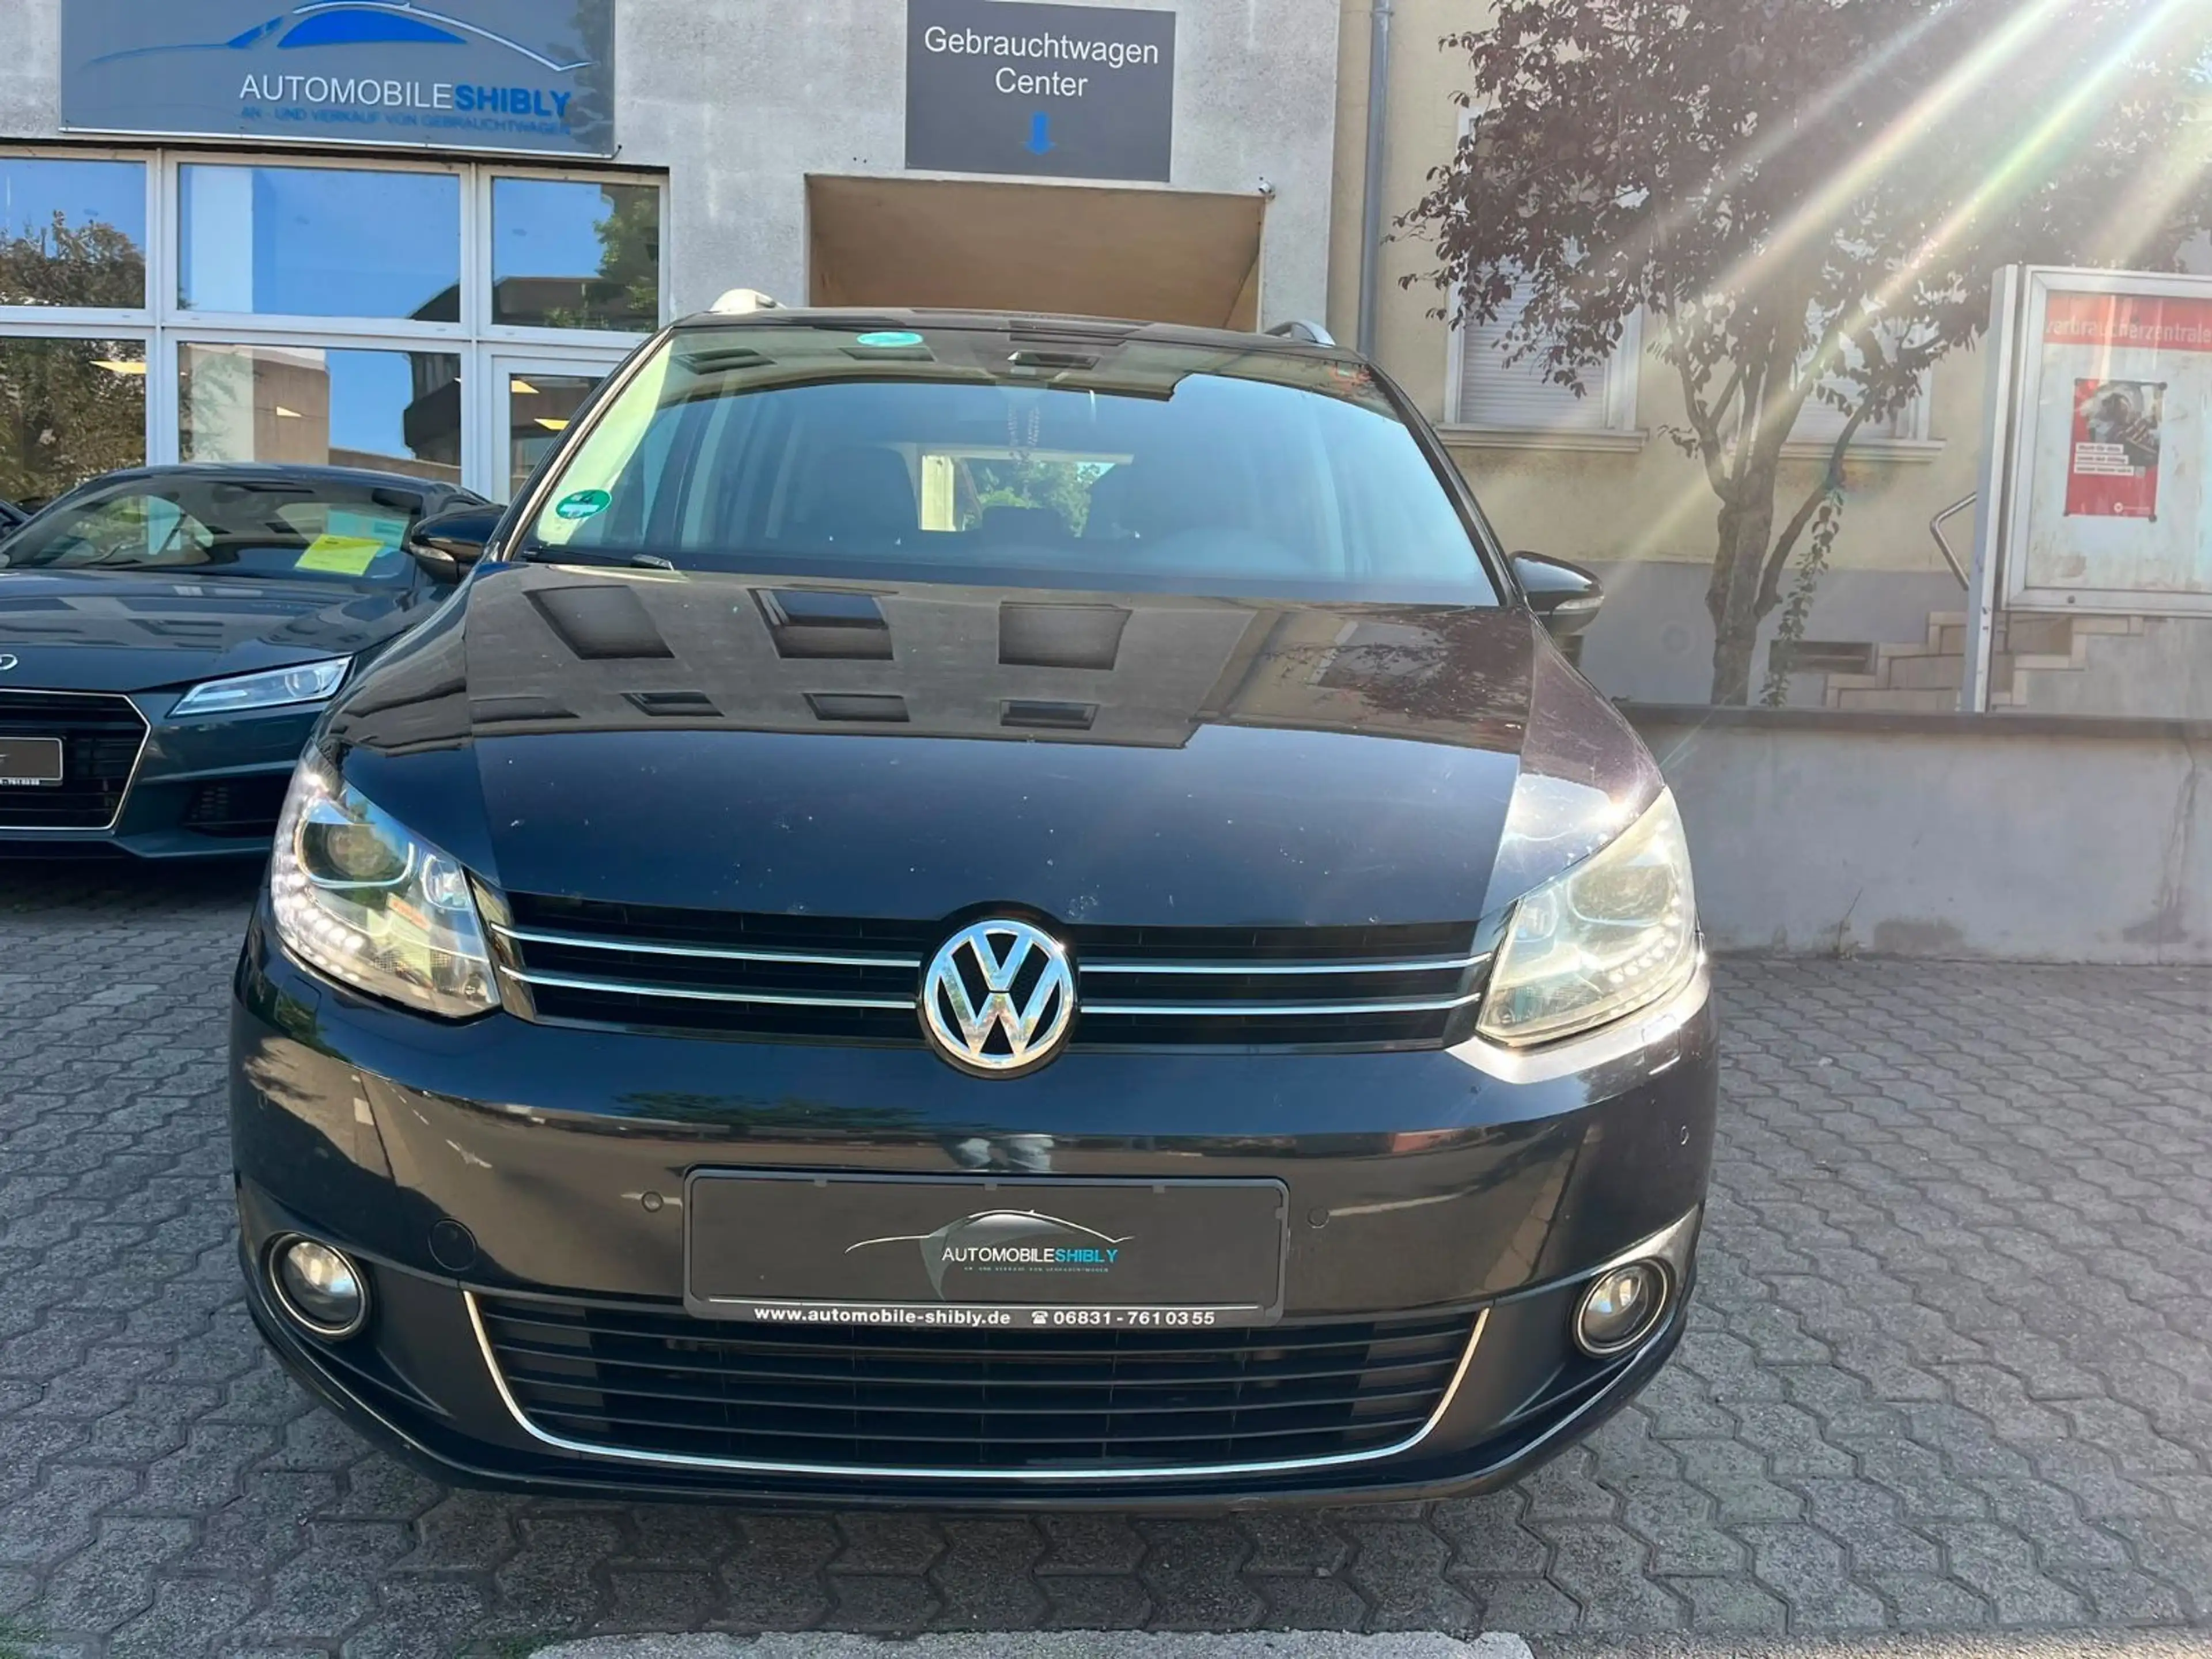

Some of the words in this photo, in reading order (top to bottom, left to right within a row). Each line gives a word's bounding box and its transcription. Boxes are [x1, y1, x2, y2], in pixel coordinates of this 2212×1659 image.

[925, 26, 1159, 69] Gebrauchtwagen
[995, 67, 1089, 97] Center
[754, 1307, 1012, 1327] www.automobile-shibly.de
